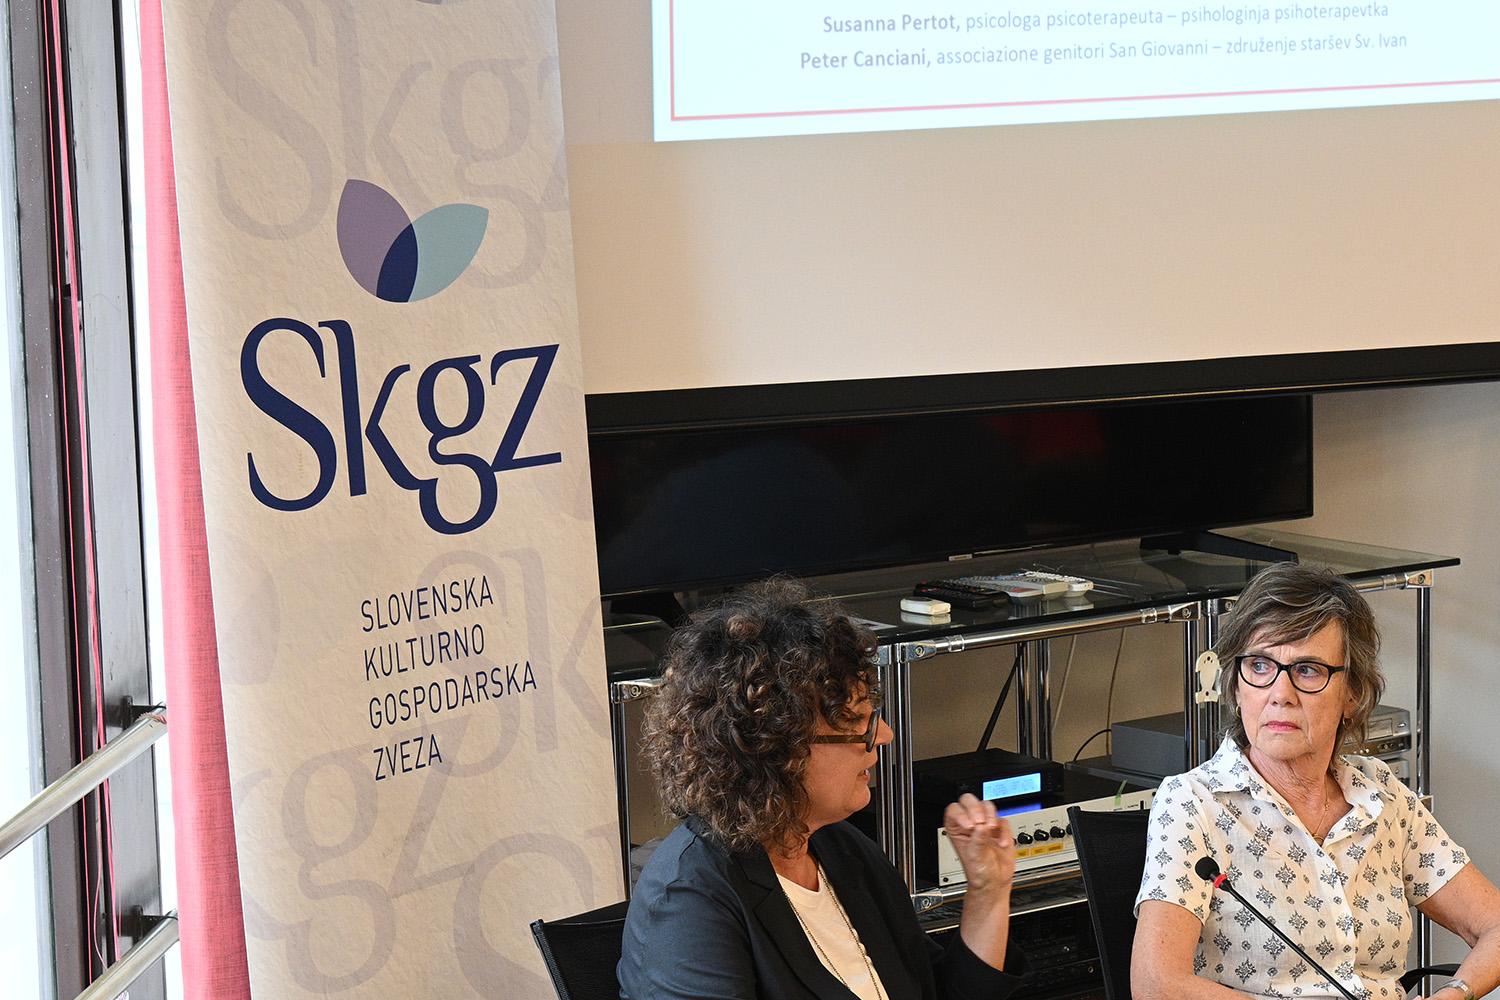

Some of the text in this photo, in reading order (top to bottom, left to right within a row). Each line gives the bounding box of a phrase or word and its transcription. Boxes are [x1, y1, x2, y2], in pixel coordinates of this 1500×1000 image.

[823, 15, 896, 33] Susanna
[901, 13, 960, 32] Pertot,
[966, 11, 1041, 31] psicologa
[1046, 9, 1163, 30] psicoterapeuta
[1181, 5, 1270, 26] psihologinja
[1275, 1, 1389, 23] psihoterapevtka
[800, 51, 848, 69] Peter
[853, 48, 931, 68] Canciani,
[936, 46, 1038, 65] associazione
[1044, 42, 1104, 64] genitori
[1109, 42, 1137, 58] San
[1141, 38, 1208, 57] Giovanni
[1226, 36, 1297, 55] združenje
[1301, 34, 1351, 51] staršev
[1355, 34, 1375, 49] Sv.
[1379, 33, 1407, 48] Ivan
[240, 317, 562, 535] Skgz
[361, 575, 494, 632] SLOVENSKA
[364, 623, 485, 681] KULTURNO
[369, 660, 537, 729] GOSPODARSKA
[373, 733, 443, 781] ZVEZA
